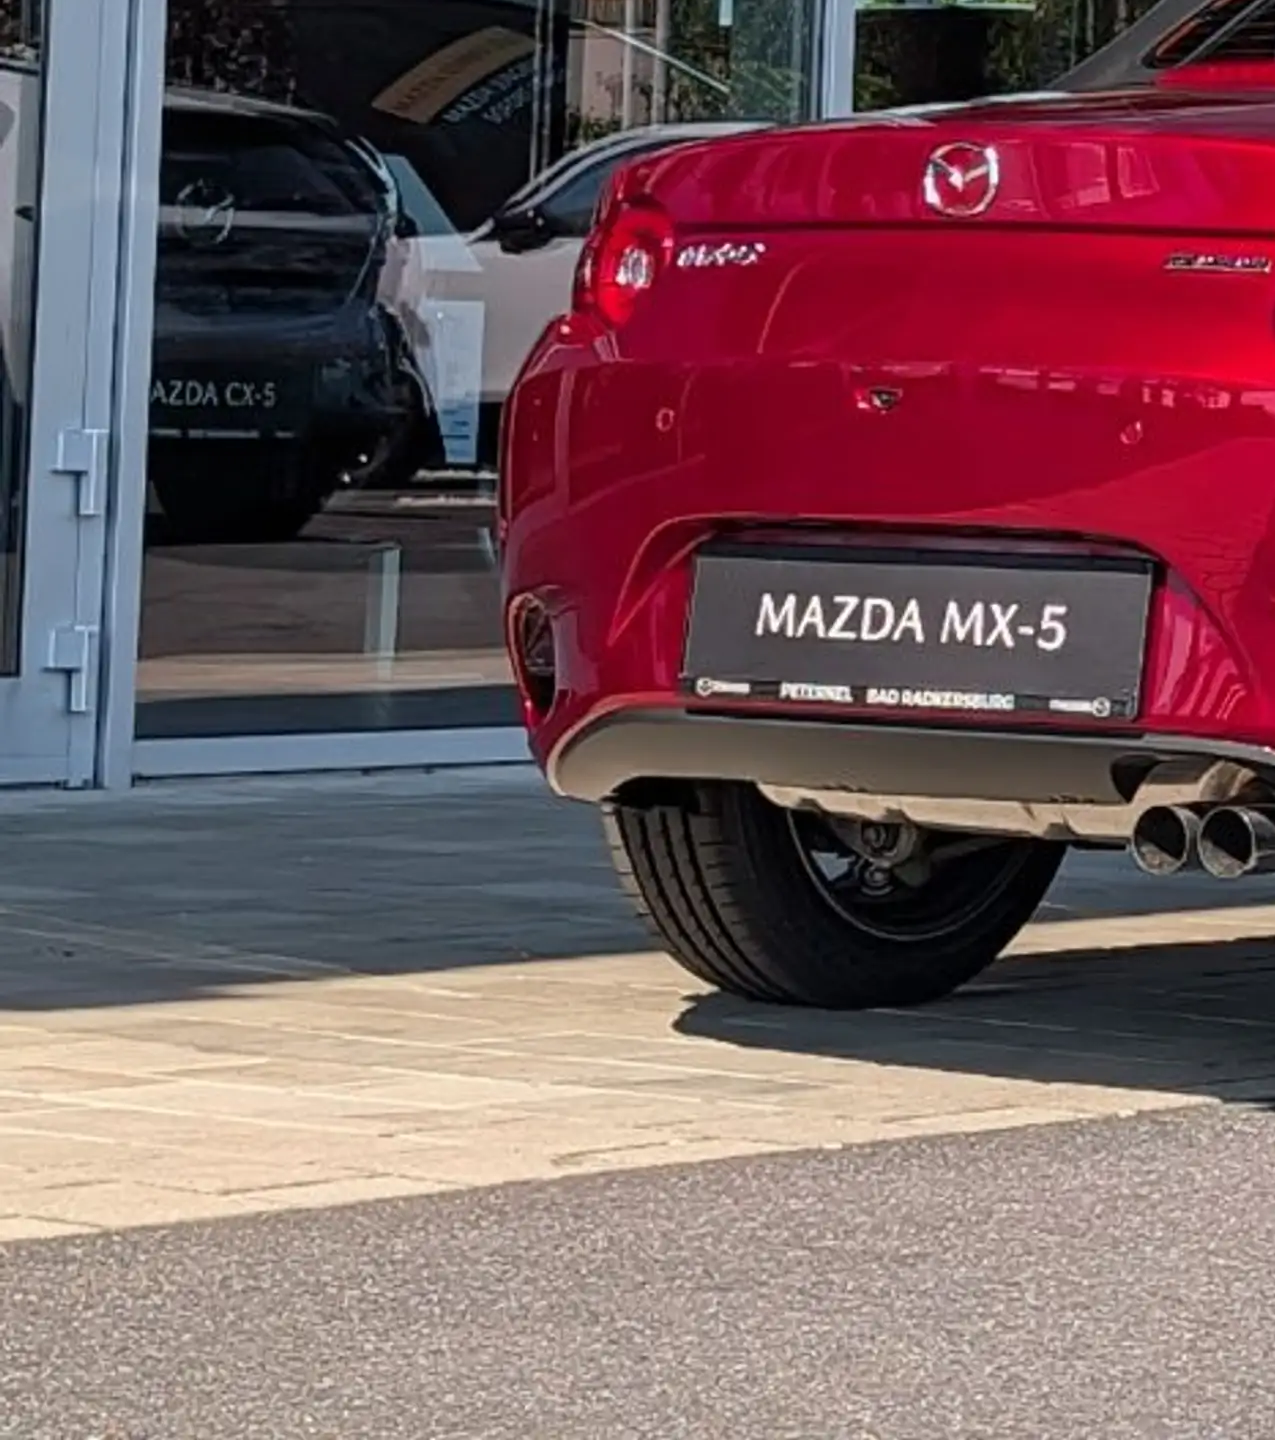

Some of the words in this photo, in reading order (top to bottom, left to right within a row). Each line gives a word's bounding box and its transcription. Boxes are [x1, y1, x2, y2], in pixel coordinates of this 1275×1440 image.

[151, 380, 219, 406] AZDA
[225, 381, 278, 407] CX-5
[755, 592, 925, 643] MAZDA
[940, 600, 1070, 652] MX-5
[866, 687, 899, 705] BAD
